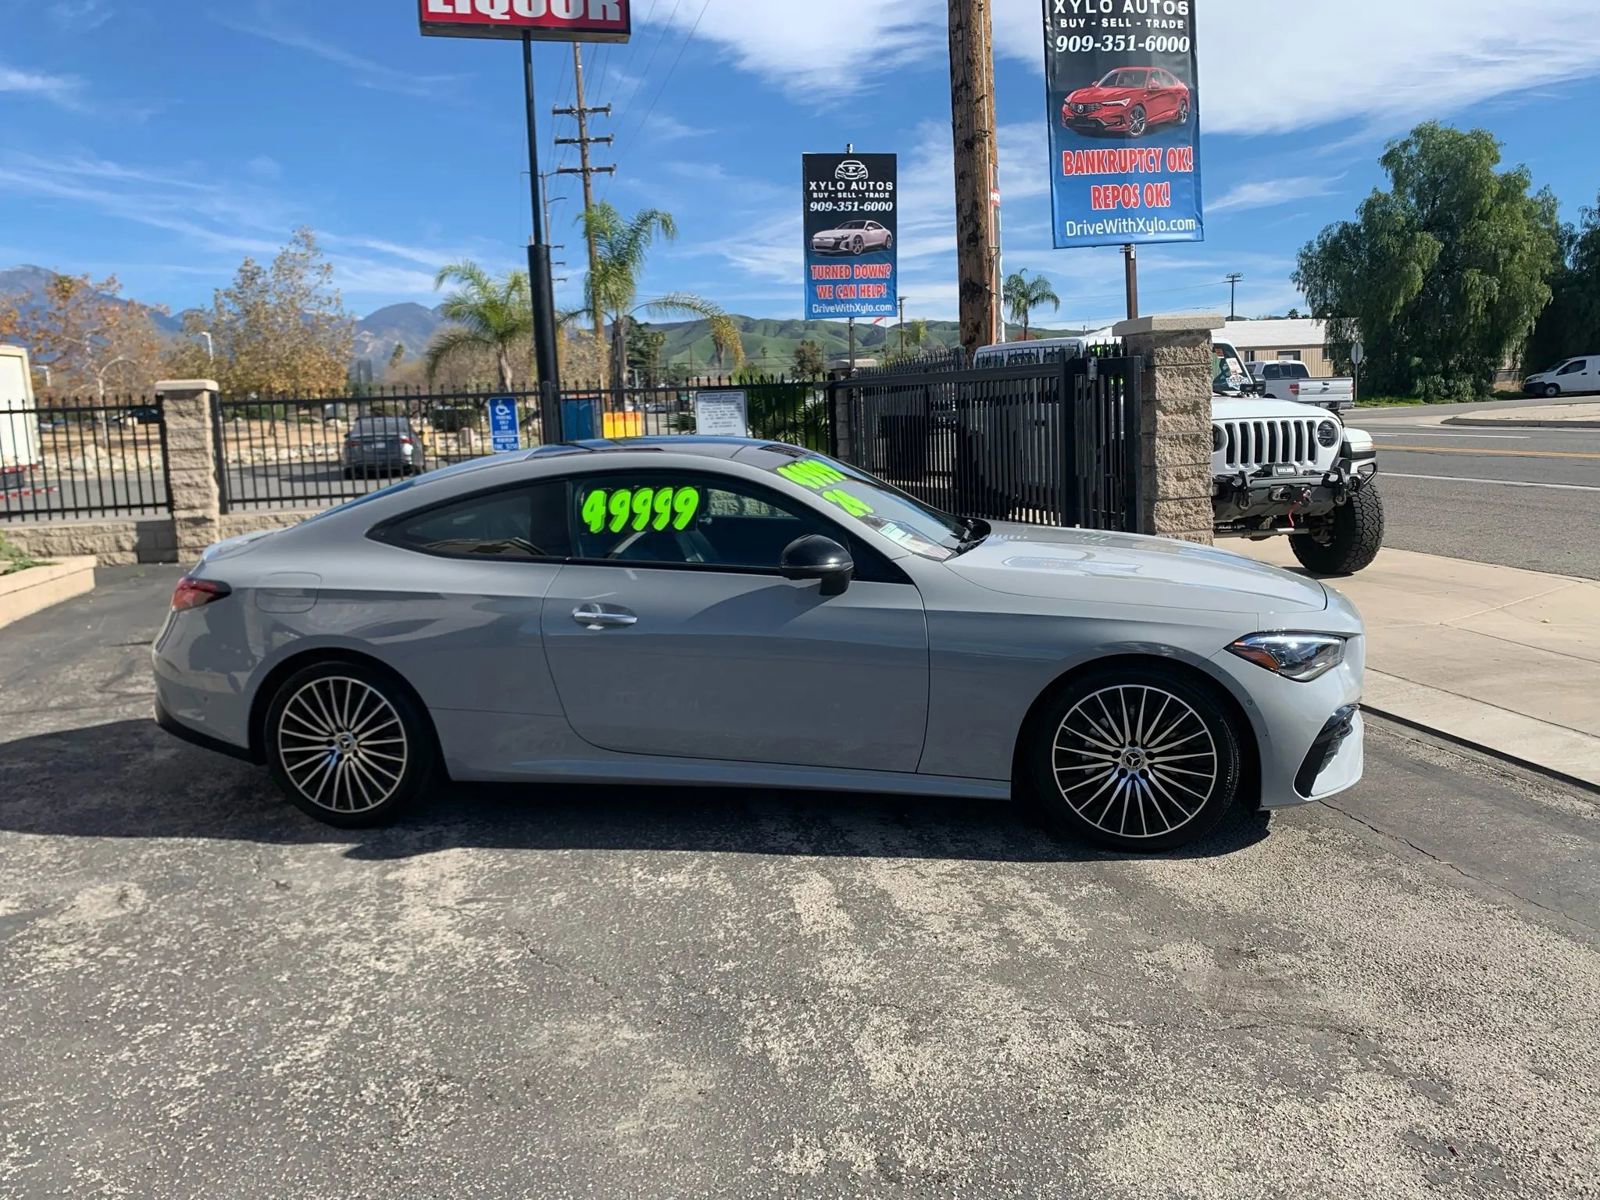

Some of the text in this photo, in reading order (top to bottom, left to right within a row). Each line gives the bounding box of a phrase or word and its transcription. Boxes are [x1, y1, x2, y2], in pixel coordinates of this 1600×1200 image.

[1054, 0, 1189, 15] XYLO AUTOS
[1060, 18, 1086, 28] BUY
[1101, 18, 1132, 28] SELL
[1146, 19, 1184, 29] TRADE
[1056, 35, 1190, 53] 909-351-6000
[1063, 147, 1193, 175] BANKRUPTCY OK!
[809, 182, 893, 190] XYLO AUTOS
[1091, 182, 1171, 210] REPOS OK!
[810, 202, 893, 212] 909-351-6000
[1066, 217, 1195, 237] DriveWithXylo.com
[811, 264, 891, 280] TURNED DOWN?
[817, 284, 887, 299] WE CAN HELP!
[812, 303, 892, 314] DriveWithXylo.com
[582, 487, 699, 533] 49999
